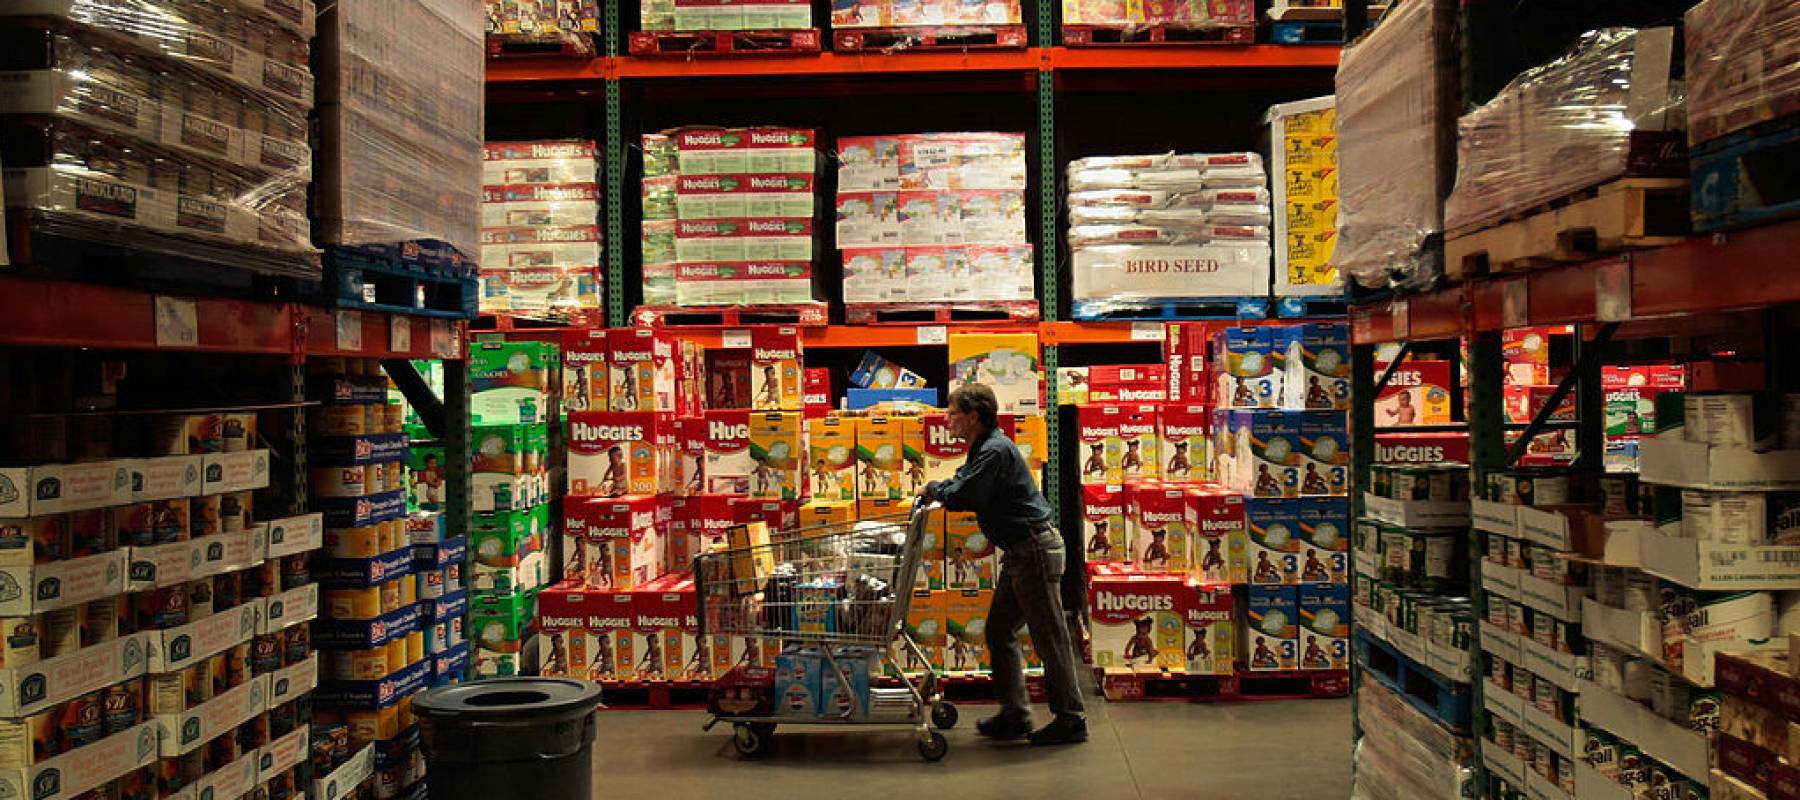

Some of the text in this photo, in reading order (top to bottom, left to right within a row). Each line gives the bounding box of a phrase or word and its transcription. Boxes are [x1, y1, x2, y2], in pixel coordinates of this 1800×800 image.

[1126, 259, 1219, 273] BIRD SEED
[1258, 379, 1272, 397] 3
[1334, 380, 1347, 399] 3
[572, 422, 643, 441] HUGGIES
[1285, 468, 1298, 486] 3
[1331, 467, 1345, 486] 3
[1283, 554, 1297, 573] 3
[1331, 554, 1345, 573] 3
[1096, 591, 1173, 611] HUGGIES
[1280, 640, 1294, 659] 3
[1331, 640, 1345, 659] 3
